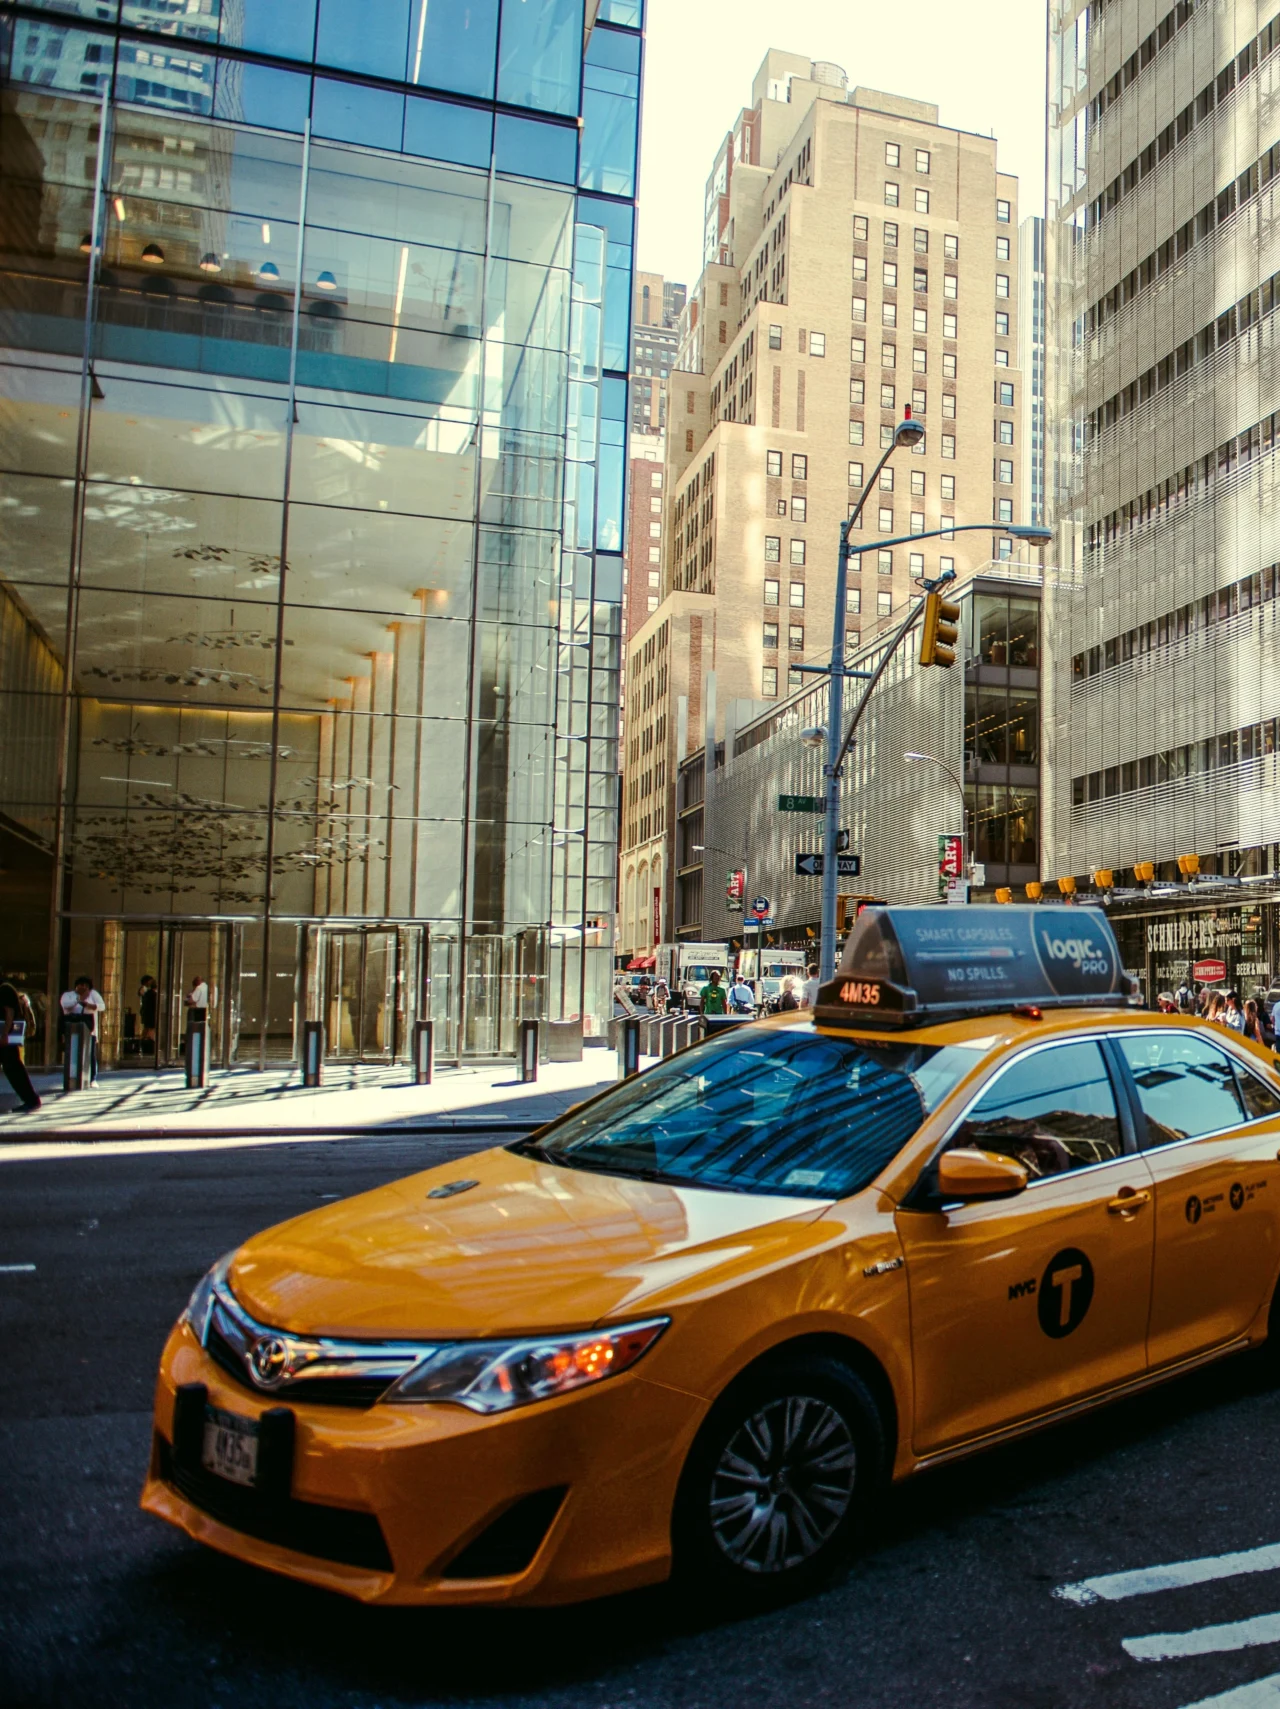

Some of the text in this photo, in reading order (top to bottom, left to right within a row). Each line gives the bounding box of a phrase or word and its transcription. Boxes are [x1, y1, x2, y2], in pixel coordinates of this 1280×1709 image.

[786, 797, 795, 810] 8
[944, 839, 957, 874] ART
[730, 872, 740, 896] ART
[1216, 916, 1242, 932] QUALITY
[916, 927, 954, 942] SMART
[1147, 918, 1214, 953] SCHNIPPER'S
[1216, 932, 1242, 948] KITCHEN
[947, 968, 965, 981] NO
[1082, 960, 1108, 975] PRO
[1236, 963, 1250, 976] BEER
[839, 981, 881, 1005] 4M35
[1008, 1278, 1037, 1301] NYC
